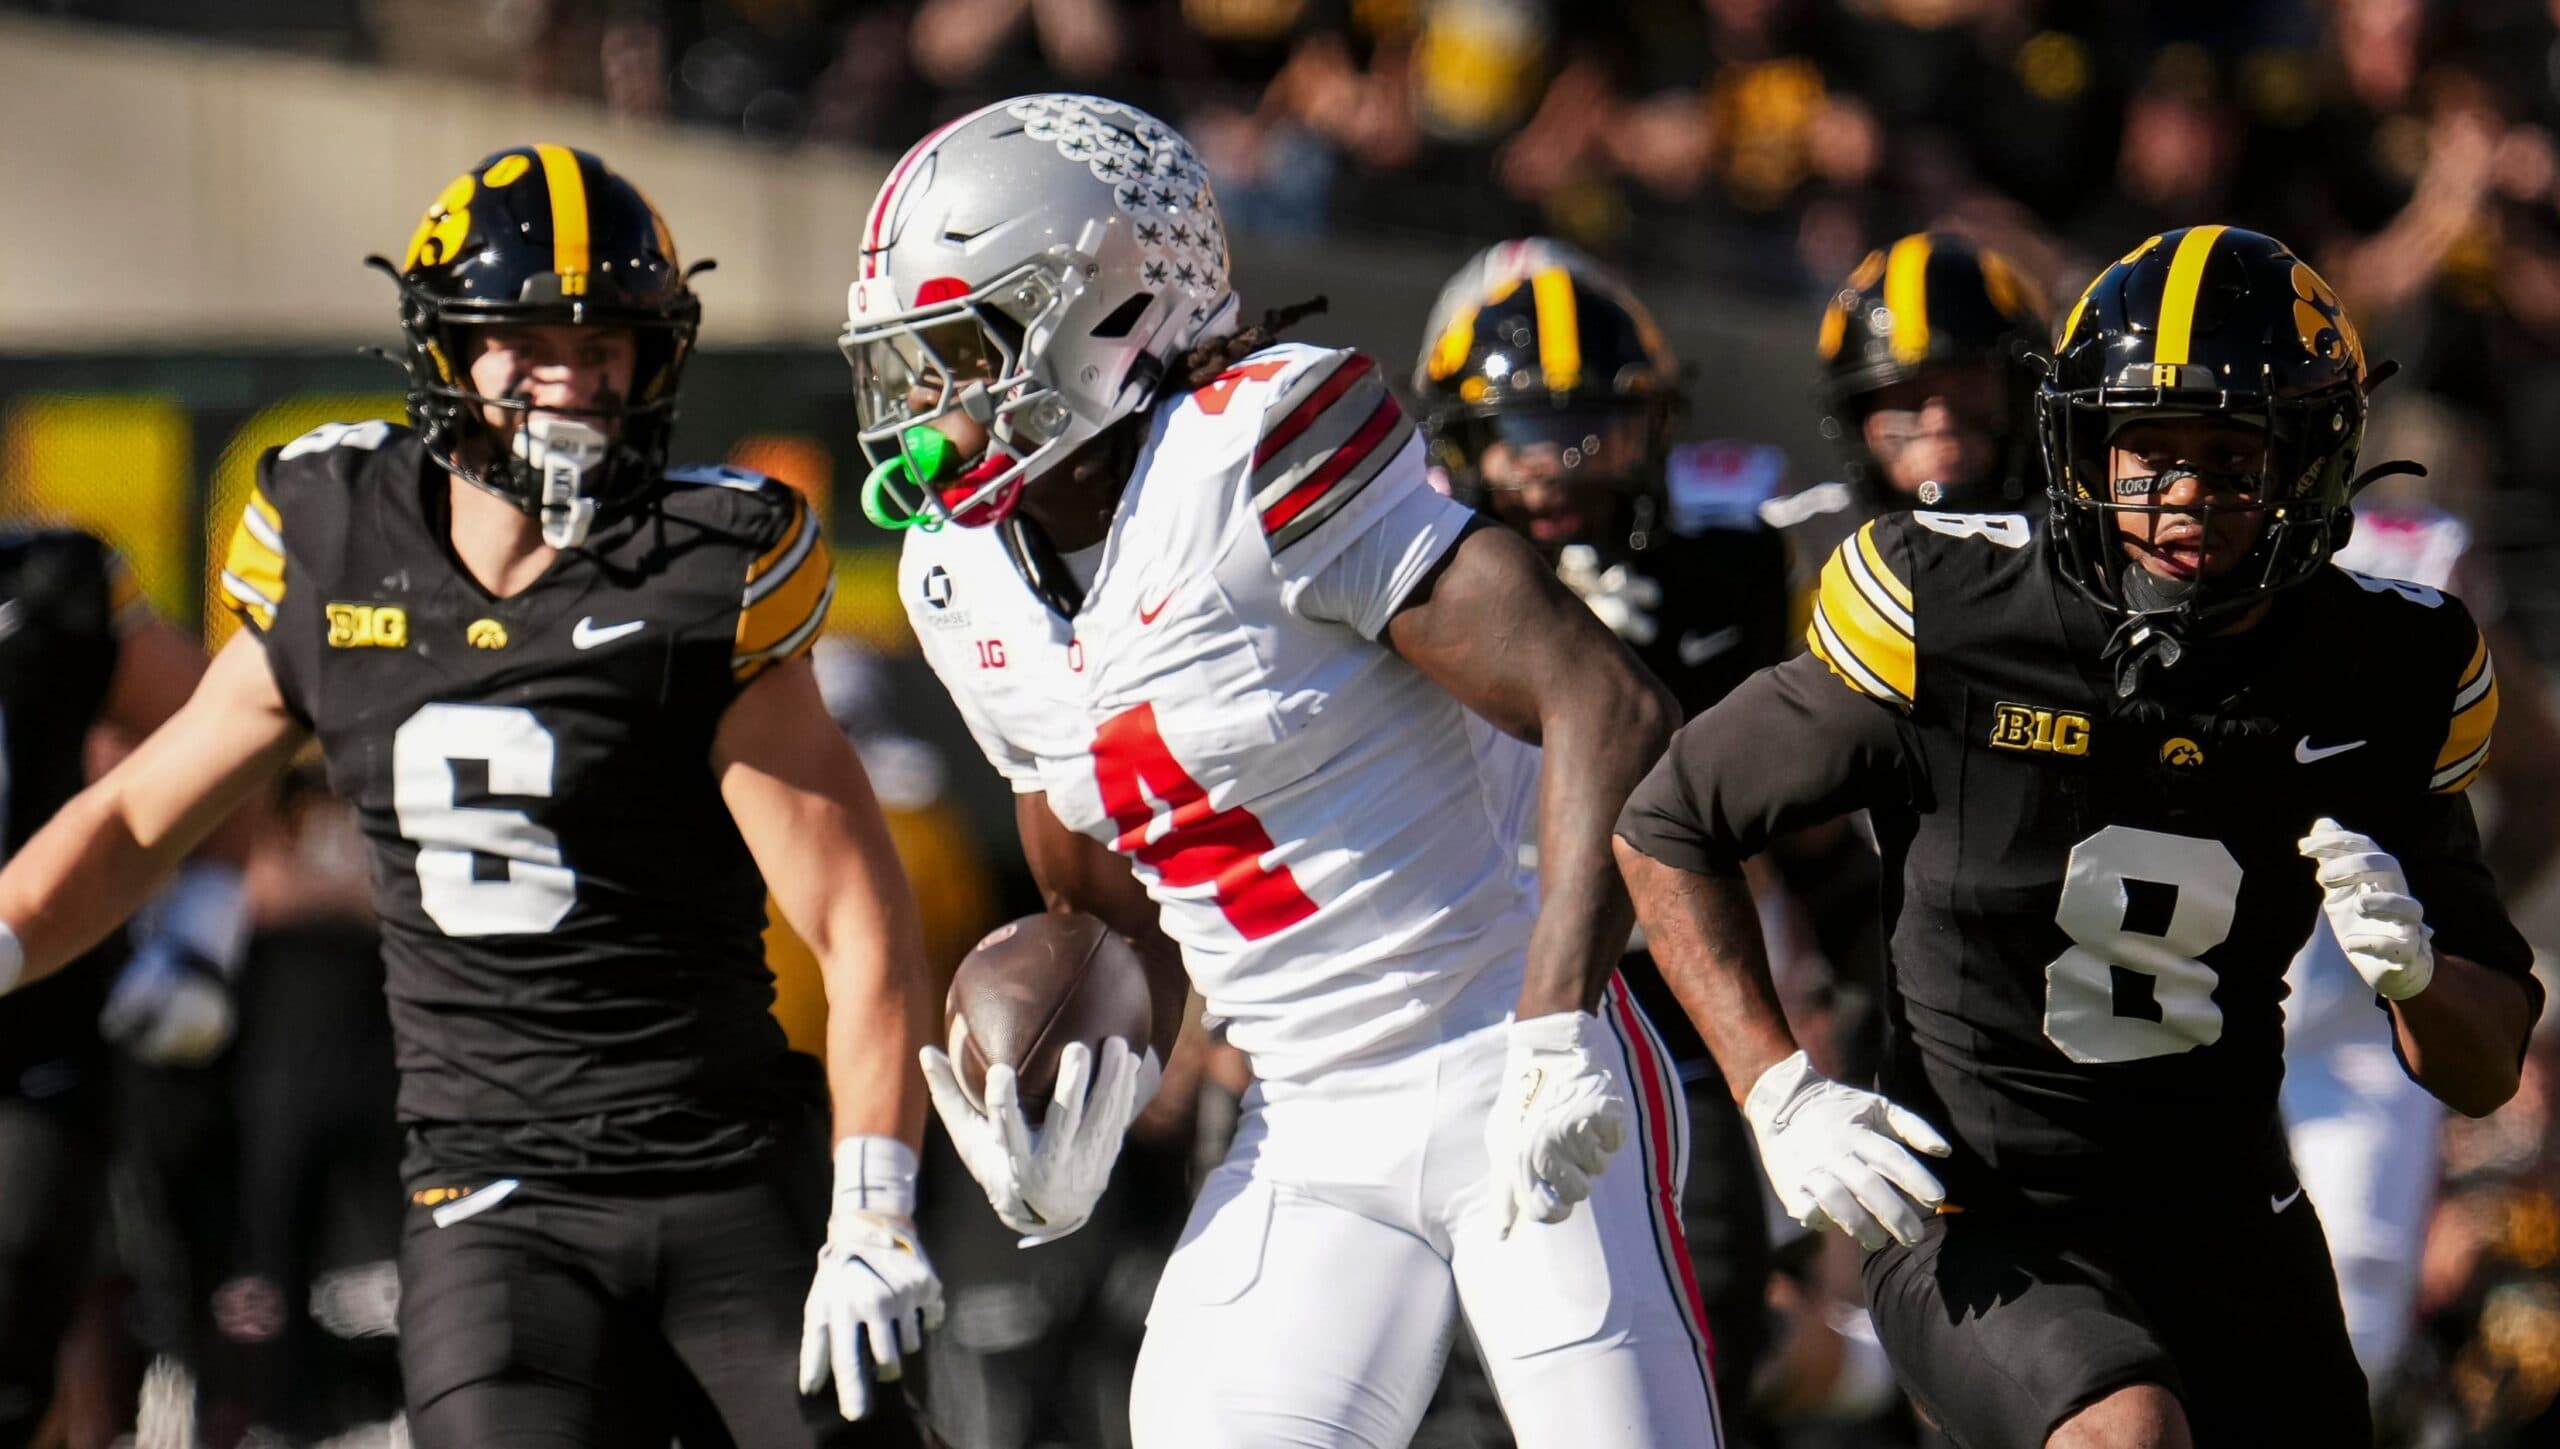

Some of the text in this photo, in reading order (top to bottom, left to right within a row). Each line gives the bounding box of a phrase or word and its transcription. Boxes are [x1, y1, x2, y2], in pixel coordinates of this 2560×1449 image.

[1912, 509, 2031, 549] 8
[393, 702, 577, 937] 6
[1089, 700, 1321, 943] 4
[2043, 824, 2245, 1064] 8
